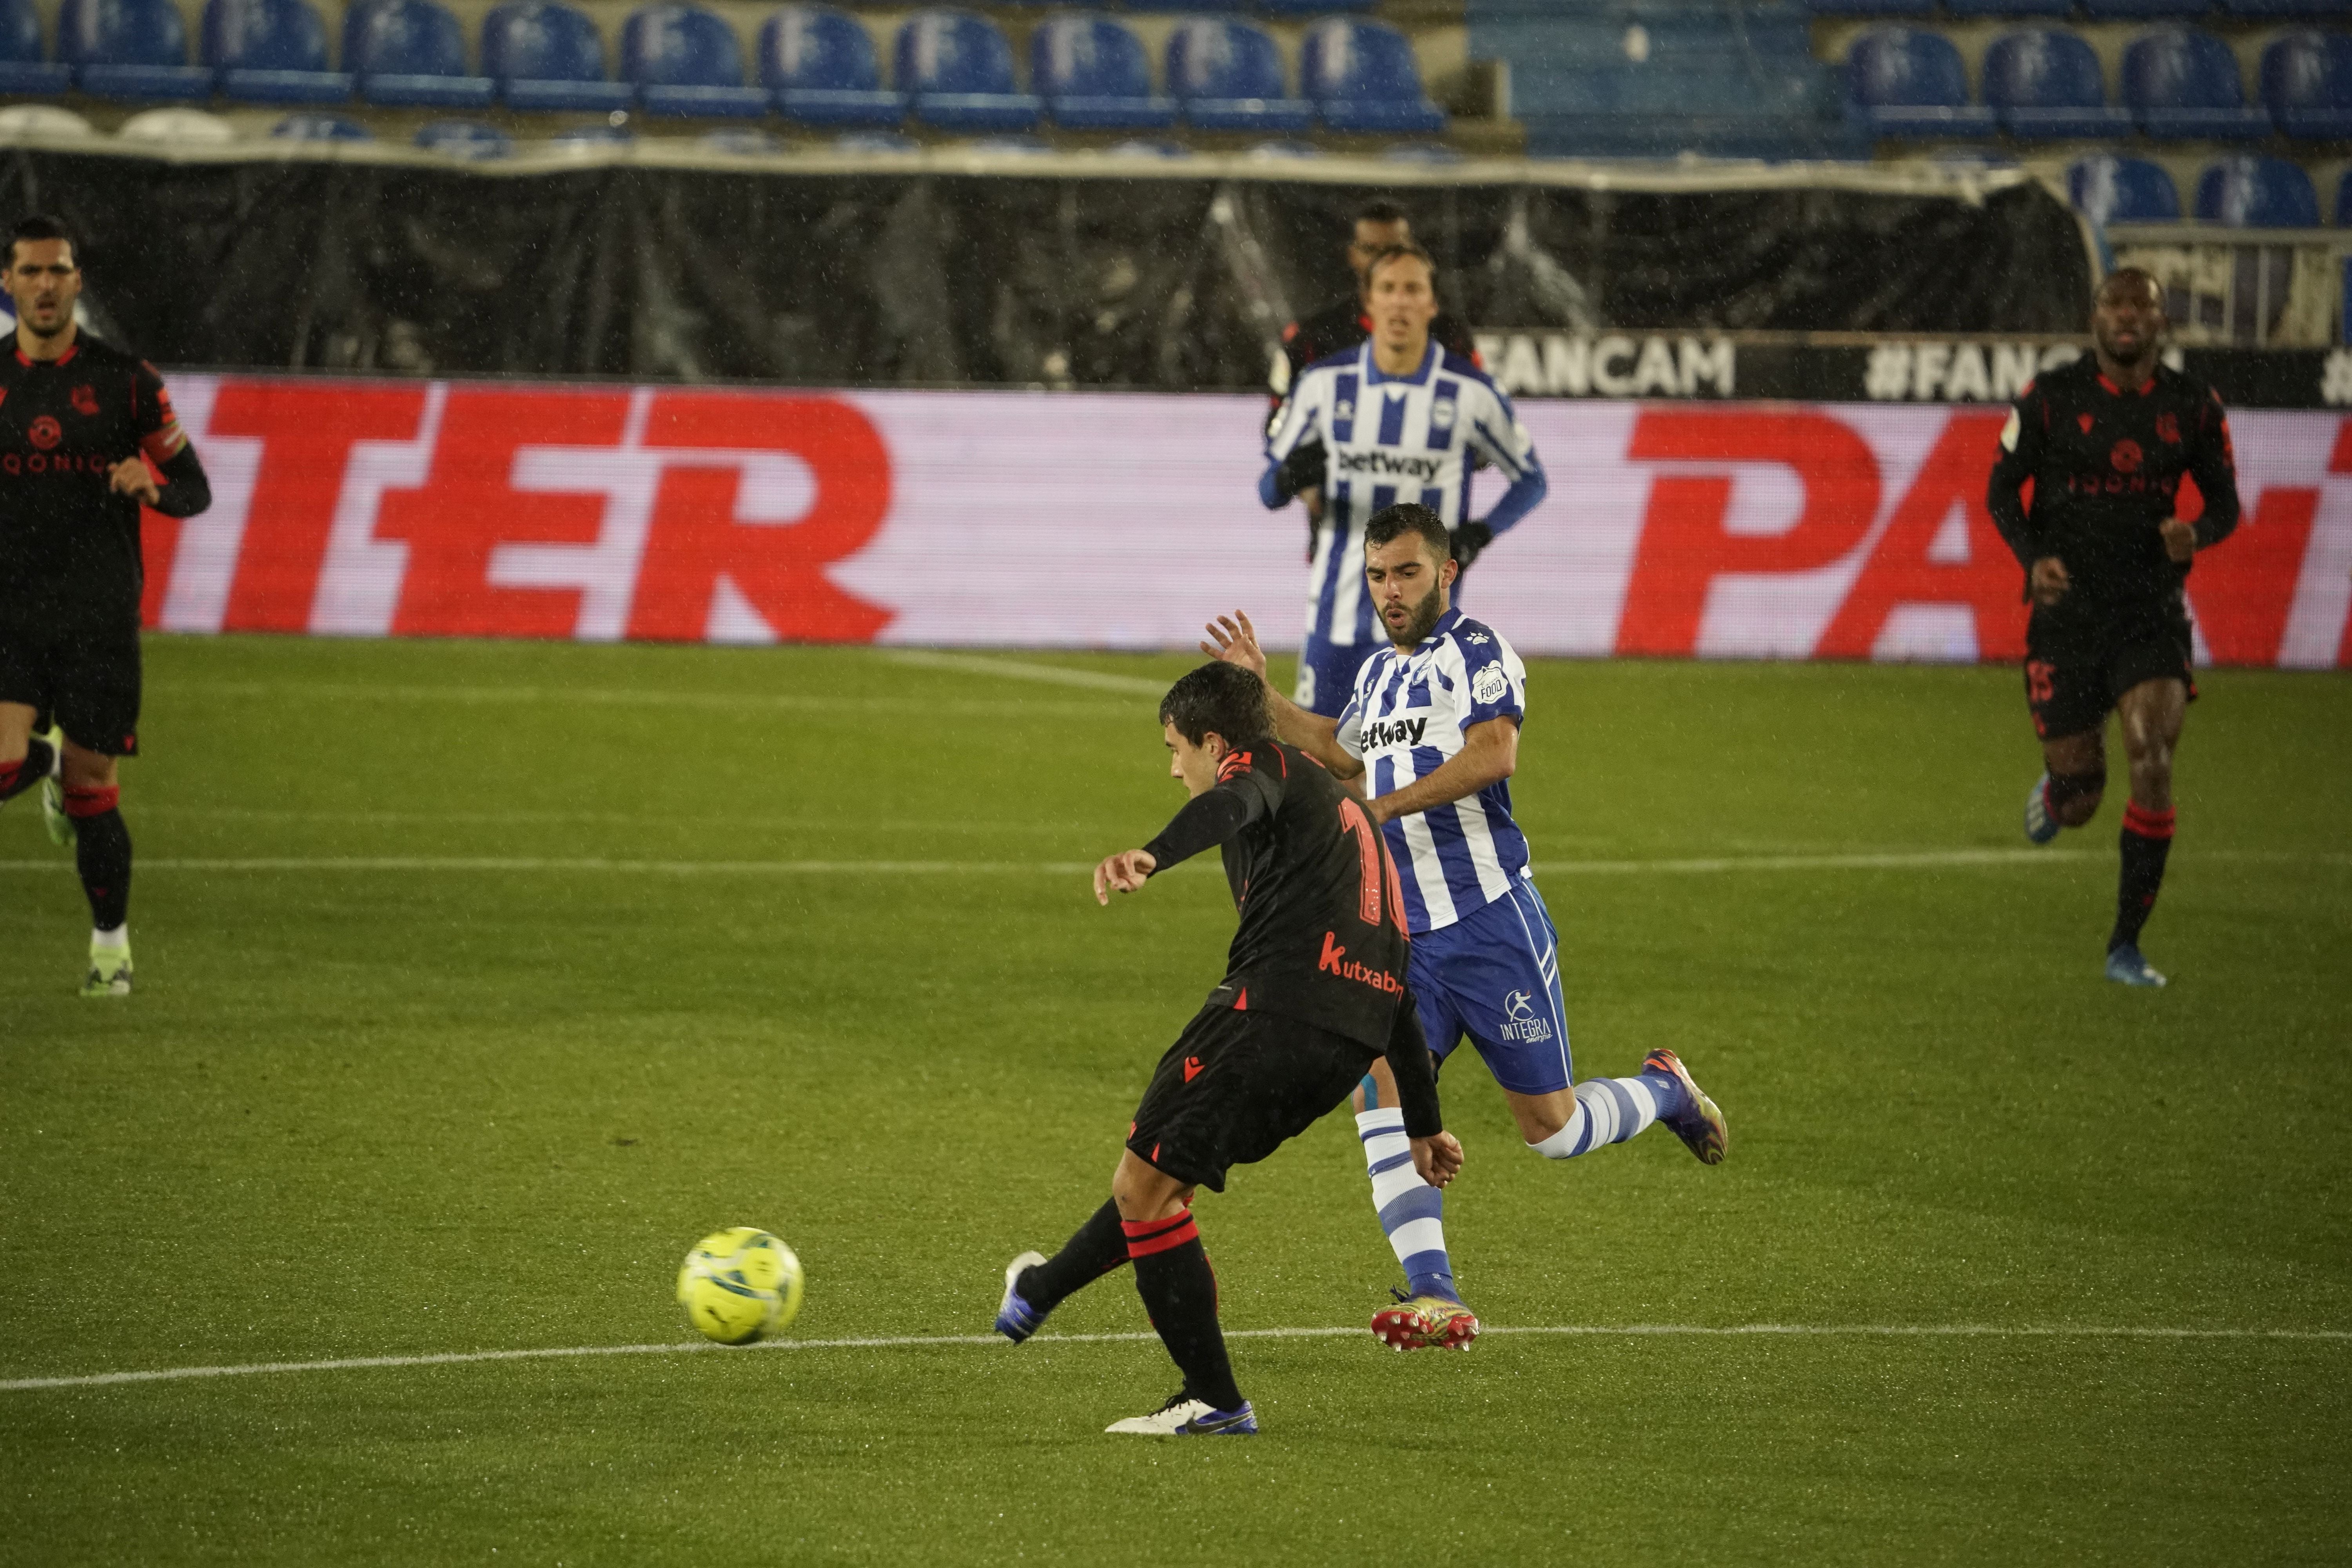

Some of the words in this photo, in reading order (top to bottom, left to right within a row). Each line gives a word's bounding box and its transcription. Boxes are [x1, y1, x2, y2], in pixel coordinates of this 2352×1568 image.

[1338, 450, 1443, 484] betway
[1481, 679, 1503, 700] FOOD
[1500, 1017, 1551, 1041] INTEGRA
